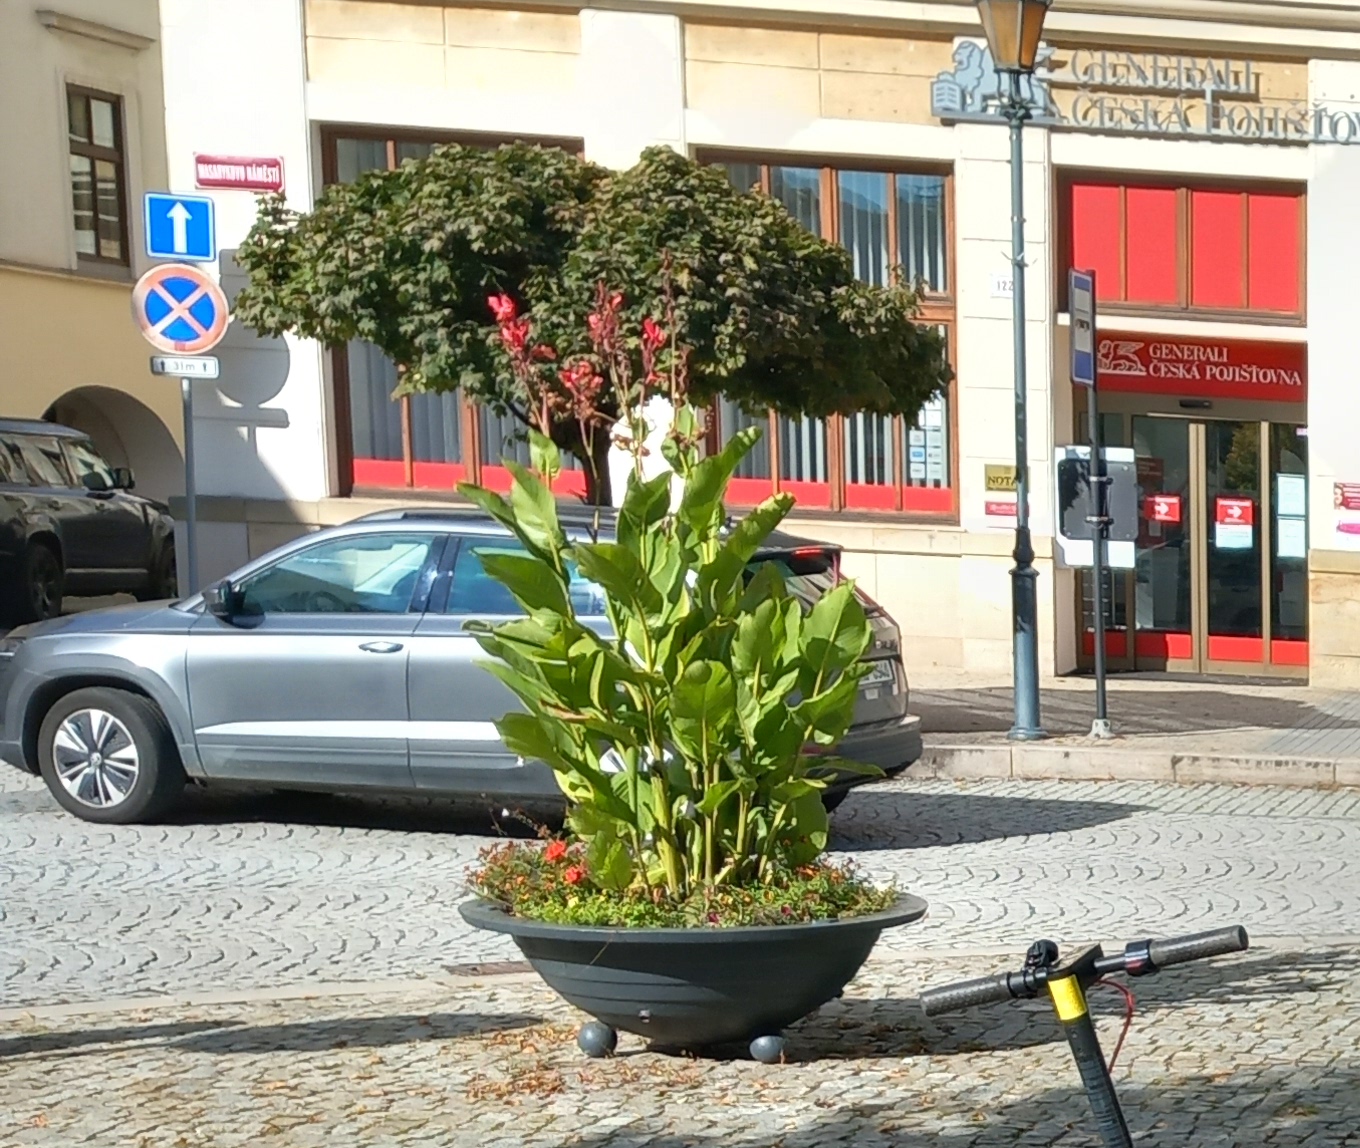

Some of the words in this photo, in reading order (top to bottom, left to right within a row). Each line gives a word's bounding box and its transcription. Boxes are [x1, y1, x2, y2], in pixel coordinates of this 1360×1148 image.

[1071, 48, 1254, 93] GENERALI
[1071, 86, 1188, 133] ČESKÁ
[1149, 342, 1229, 363] GENERALI
[1148, 359, 1202, 381] ČESKÁ
[1205, 363, 1302, 386] POJIŠŤOVNA
